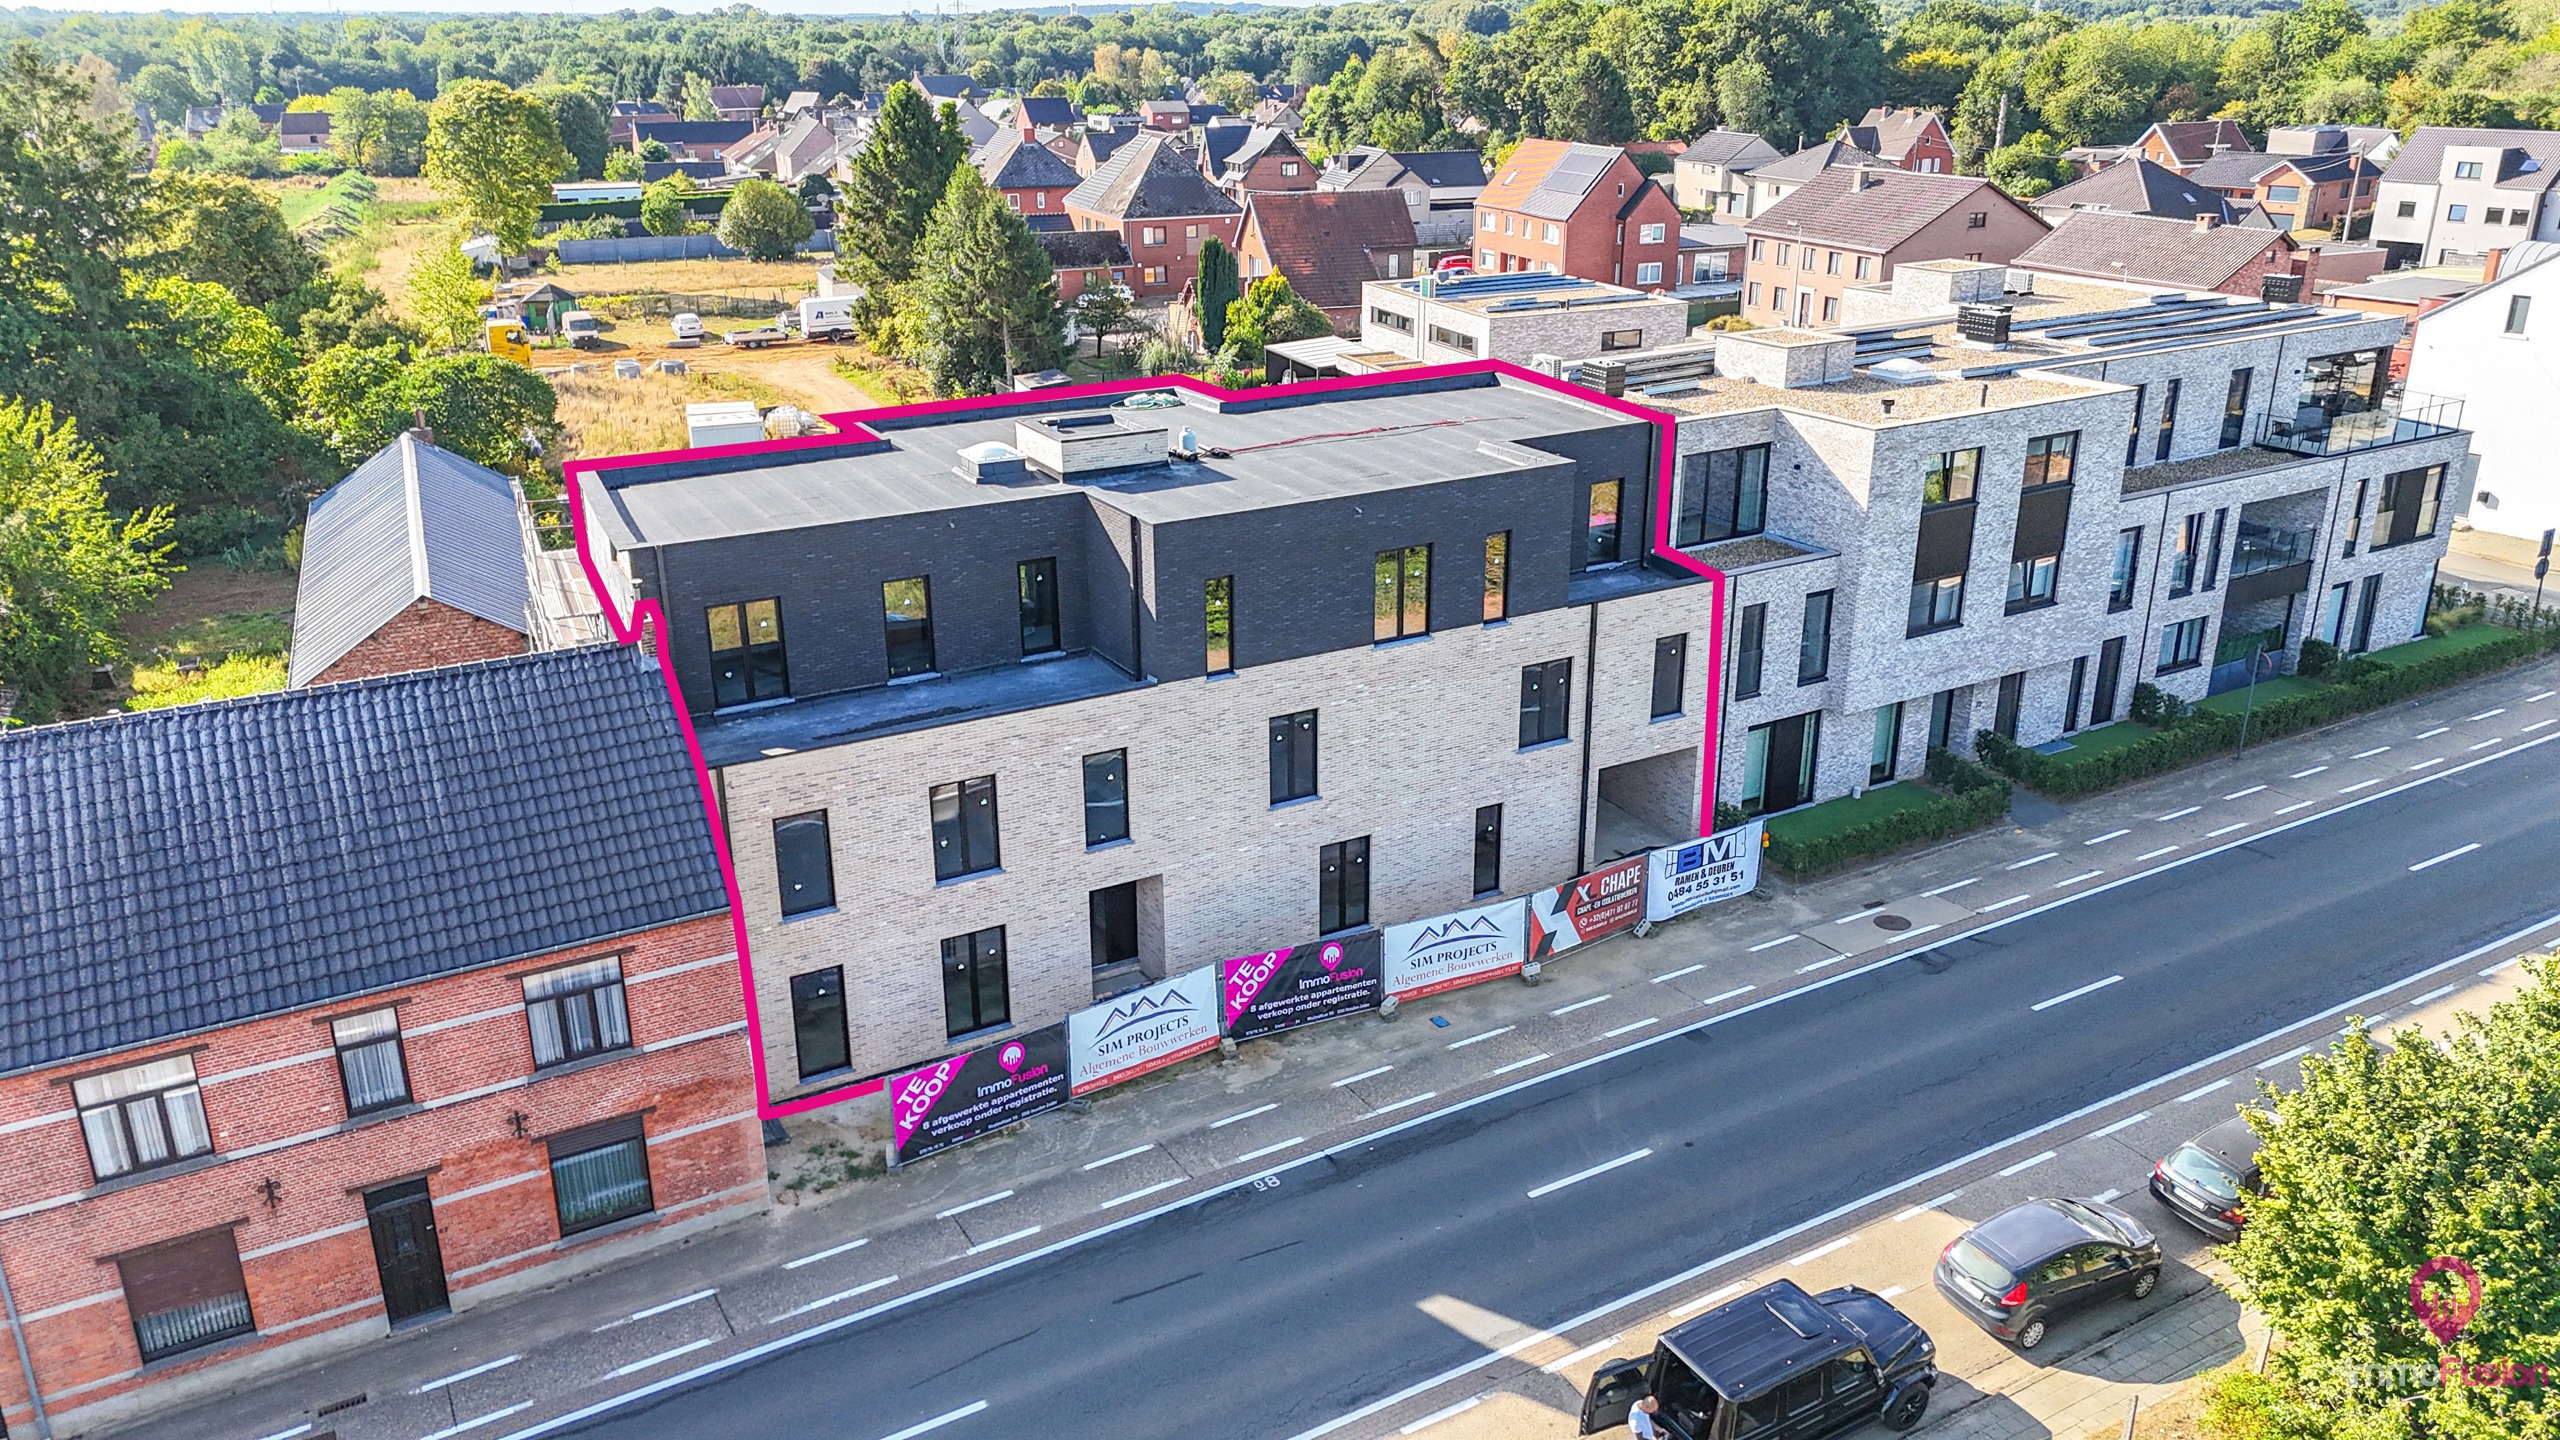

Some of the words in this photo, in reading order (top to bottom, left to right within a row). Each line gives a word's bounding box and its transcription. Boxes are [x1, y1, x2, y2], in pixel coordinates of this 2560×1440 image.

[1600, 864, 1642, 896] CHAPE
[1668, 885, 1692, 901] 0484
[1696, 880, 1709, 891] 55
[1713, 875, 1726, 886] 31
[1731, 870, 1744, 881] 51
[1675, 871, 1699, 886] RAMEN
[1700, 870, 1707, 879] &
[1708, 861, 1735, 876] DEUREN
[1577, 903, 1592, 916] CHAPE
[1392, 967, 1444, 988] Algemene
[1447, 951, 1513, 973] Bouwwerken
[1410, 955, 1433, 970] SIM
[1437, 941, 1497, 963] PROJECTS
[1229, 960, 1255, 987] TE
[1230, 951, 1277, 1011] KOOP
[1299, 966, 1364, 990] ImmoFusion
[1250, 1004, 1257, 1013] 8
[1258, 994, 1309, 1012] afgewerkte
[1311, 978, 1377, 1001] appartementen
[1257, 1007, 1293, 1022] verkoop
[1296, 1000, 1321, 1012] onder
[1323, 988, 1371, 1006] registratie.
[1080, 1050, 1135, 1077] Algemene
[1138, 1024, 1208, 1056] Bouwwerken
[1098, 1038, 1123, 1057] SIM
[1127, 1015, 1189, 1046] PROJECTS
[897, 1076, 927, 1106] TE
[899, 1062, 950, 1131] KOOP
[977, 1063, 1049, 1098] ImmoFusion
[922, 1120, 930, 1131] 8
[932, 1100, 989, 1128] afgewerkte
[991, 1073, 1064, 1109] appartementen
[931, 1117, 972, 1137] verkoop
[974, 1105, 1004, 1121] onder
[1005, 1087, 1058, 1113] registratie.
